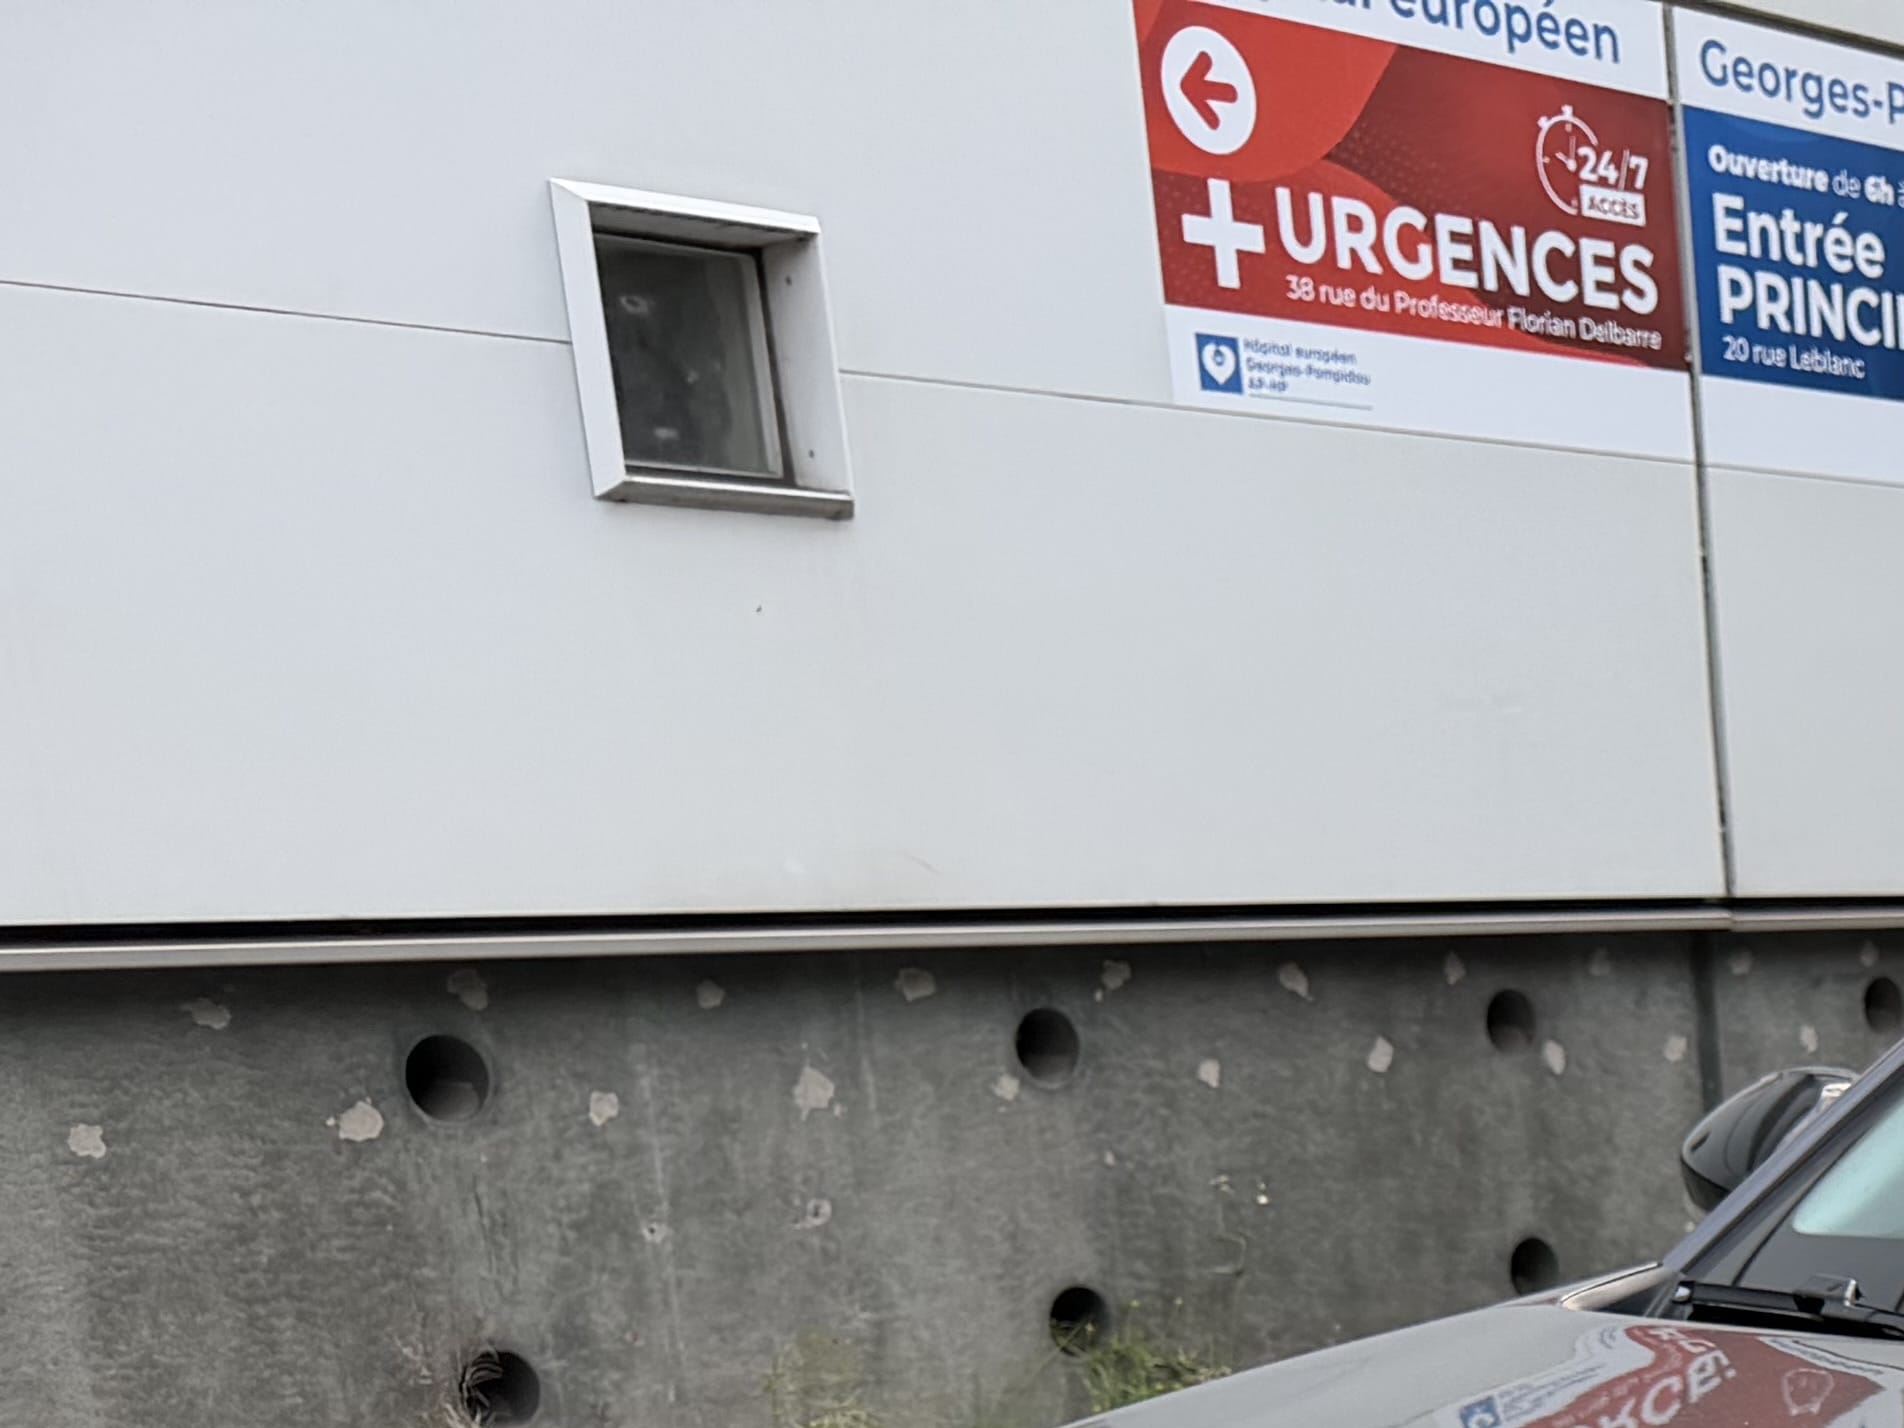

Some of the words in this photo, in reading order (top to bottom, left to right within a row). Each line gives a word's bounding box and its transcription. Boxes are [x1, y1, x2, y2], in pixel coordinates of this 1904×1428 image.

[1391, 0, 1621, 64] européen
[1577, 145, 1649, 190] 24/7
[1707, 143, 1830, 193] Ouverture
[1832, 169, 1861, 199] de
[1863, 174, 1894, 206] 6h
[1275, 186, 1659, 315] URGENCES
[1712, 192, 1885, 278] Entrée
[1285, 274, 1315, 301] 38
[1319, 284, 1356, 304] rue
[1360, 286, 1390, 312] du
[1395, 290, 1504, 330] Professeur
[1507, 306, 1575, 339] Florian
[1579, 316, 1662, 350] Delbarre
[1722, 335, 1750, 362] 20
[1752, 346, 1786, 368] rue
[1789, 345, 1866, 379] Leblanc
